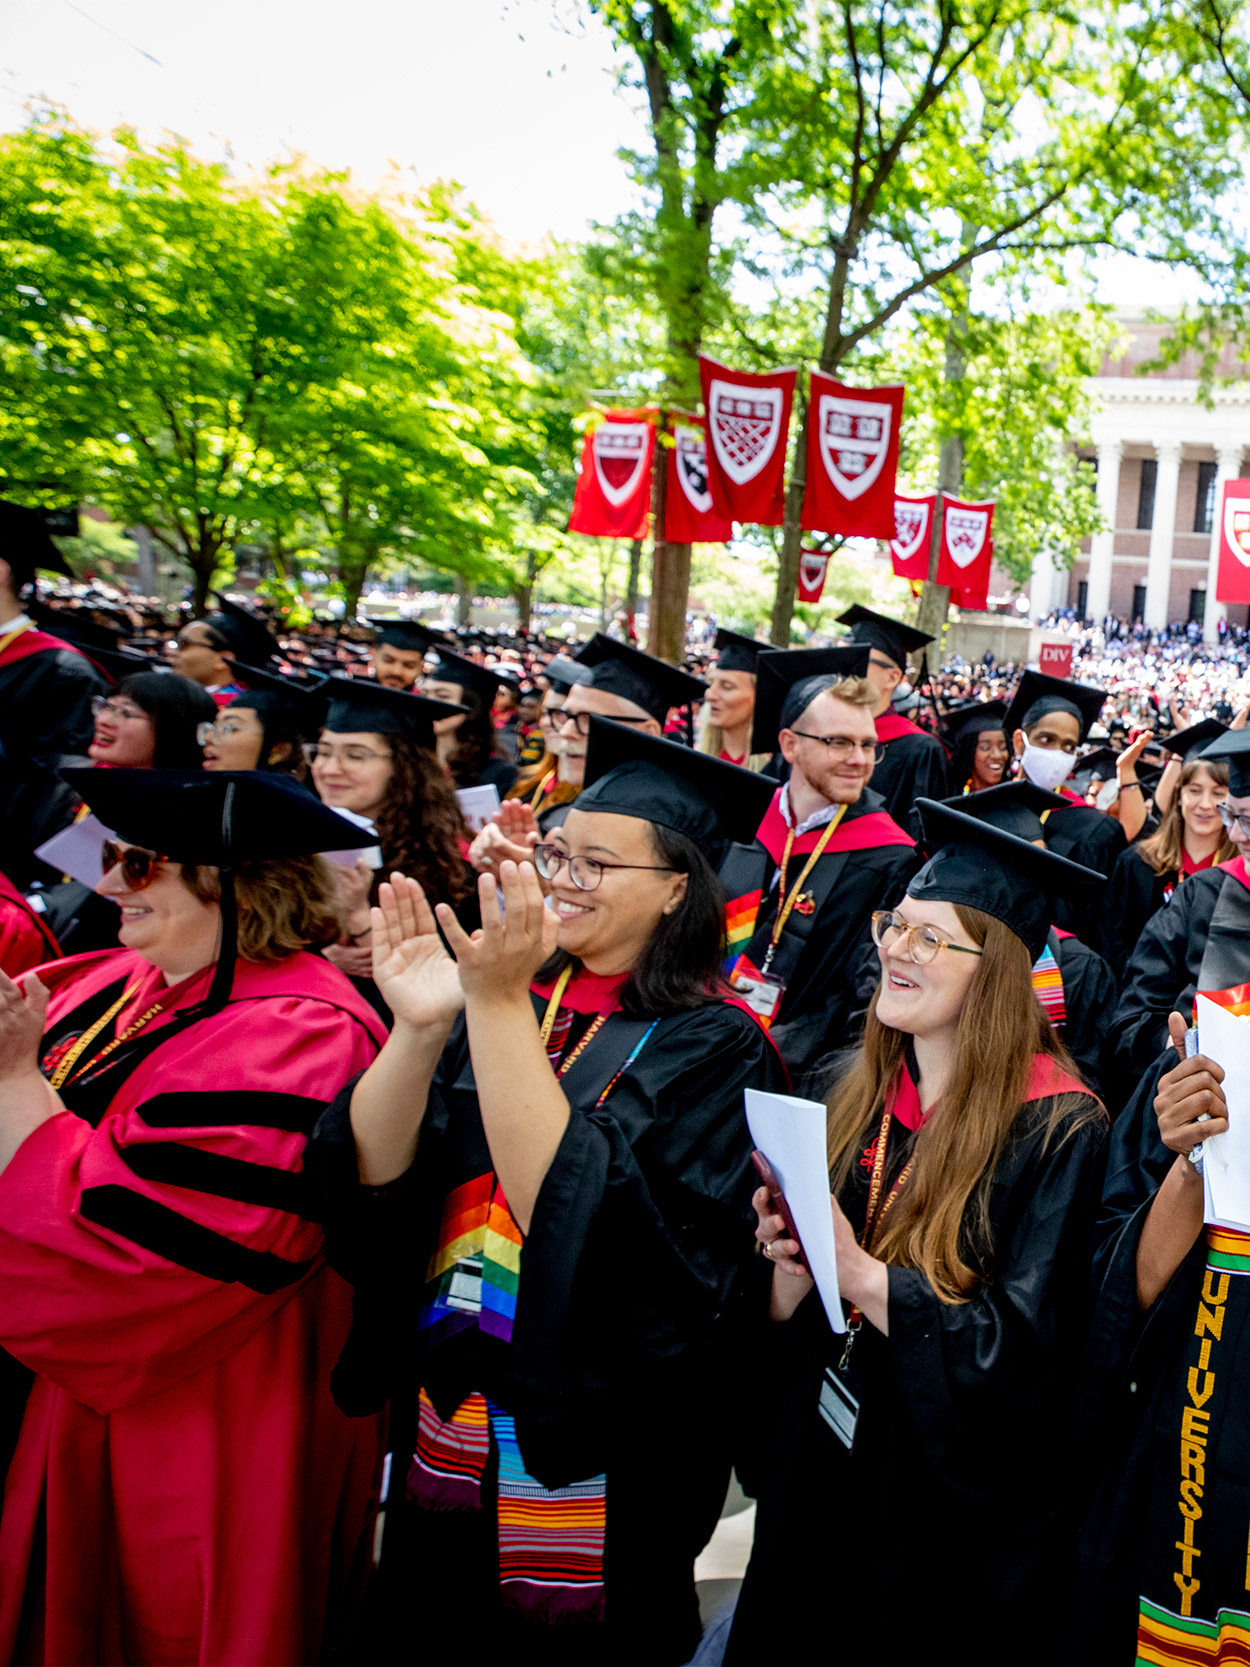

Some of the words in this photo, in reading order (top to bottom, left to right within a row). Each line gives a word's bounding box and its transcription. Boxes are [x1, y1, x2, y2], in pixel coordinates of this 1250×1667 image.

[1042, 647, 1070, 662] DIV
[101, 1003, 163, 1056] HARVARD
[560, 1015, 606, 1073] HARVARD
[1173, 1269, 1231, 1618] UNIVERSITY
